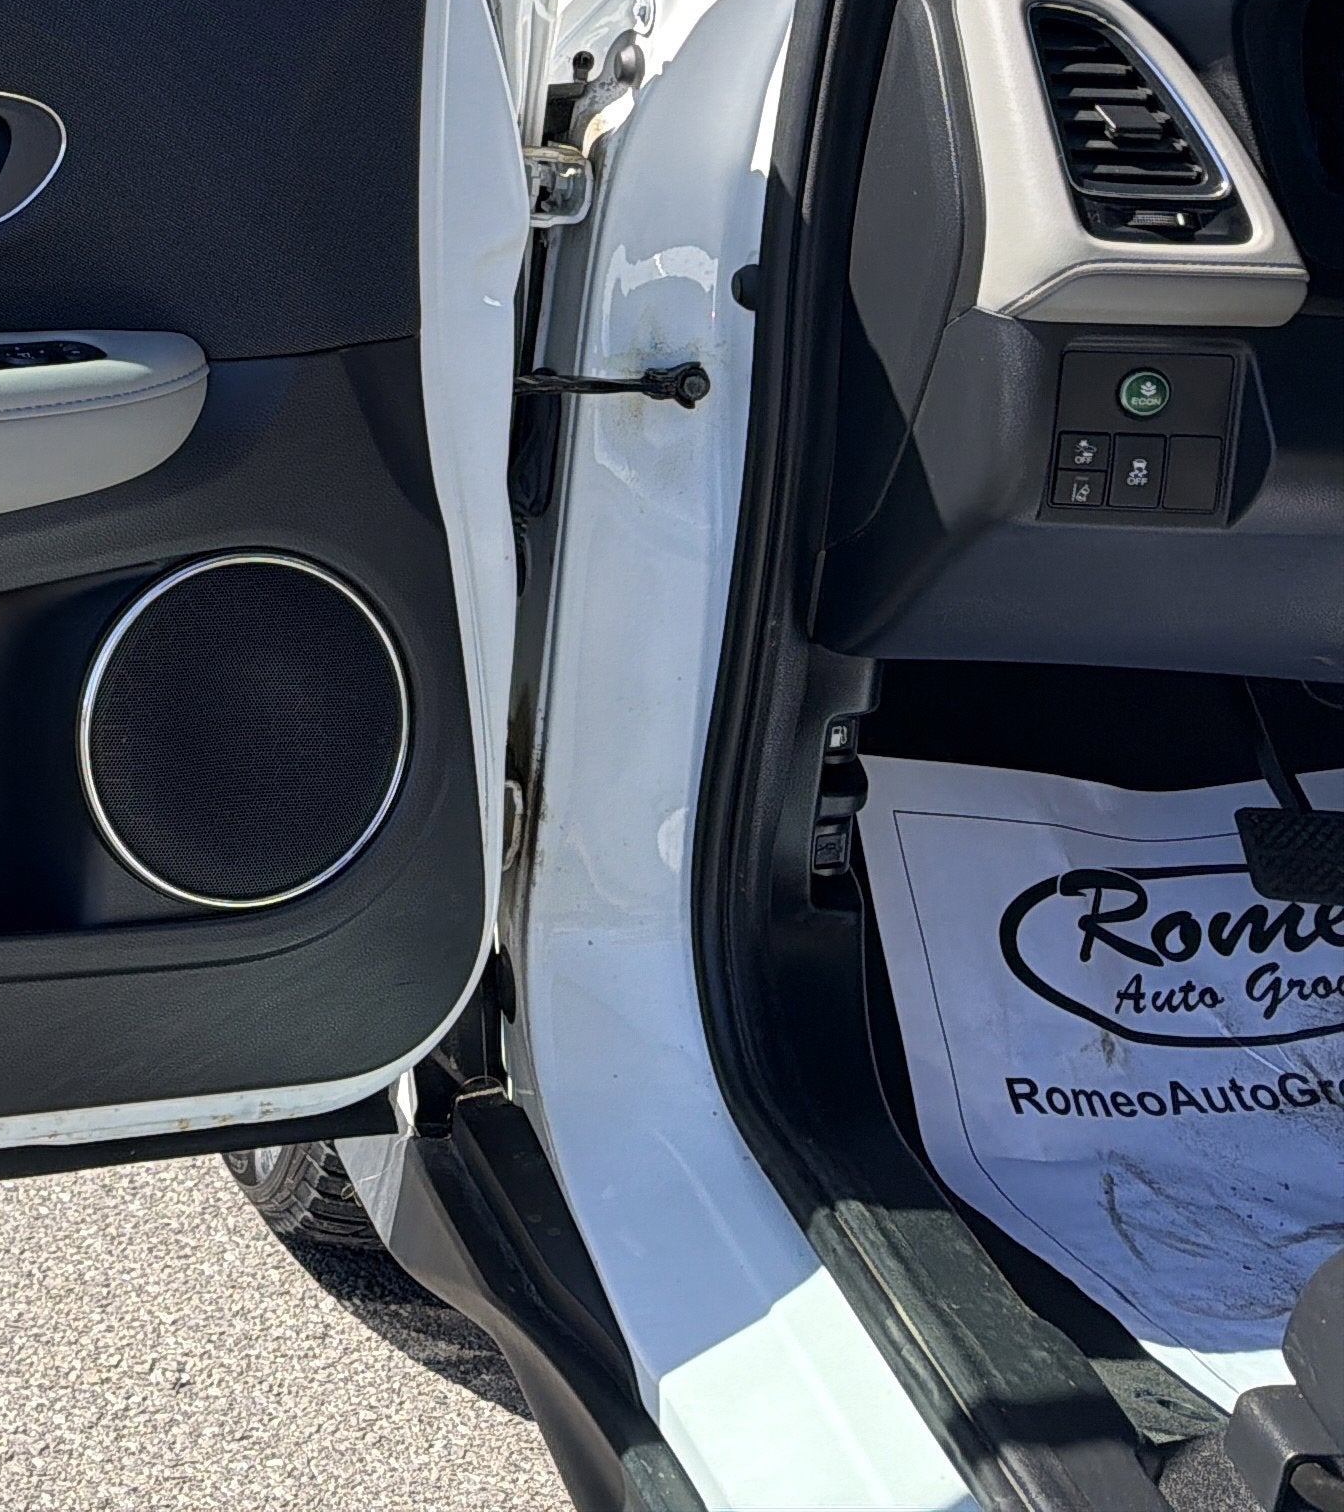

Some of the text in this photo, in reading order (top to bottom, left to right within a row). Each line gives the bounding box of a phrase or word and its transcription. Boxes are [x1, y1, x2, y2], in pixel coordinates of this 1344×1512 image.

[1131, 396, 1162, 407] ECON
[1074, 455, 1093, 465] OFF
[1126, 477, 1149, 487] OFF
[1114, 961, 1344, 1021] Auto Gro
[1005, 1071, 1344, 1119] RomeoAutoGr
